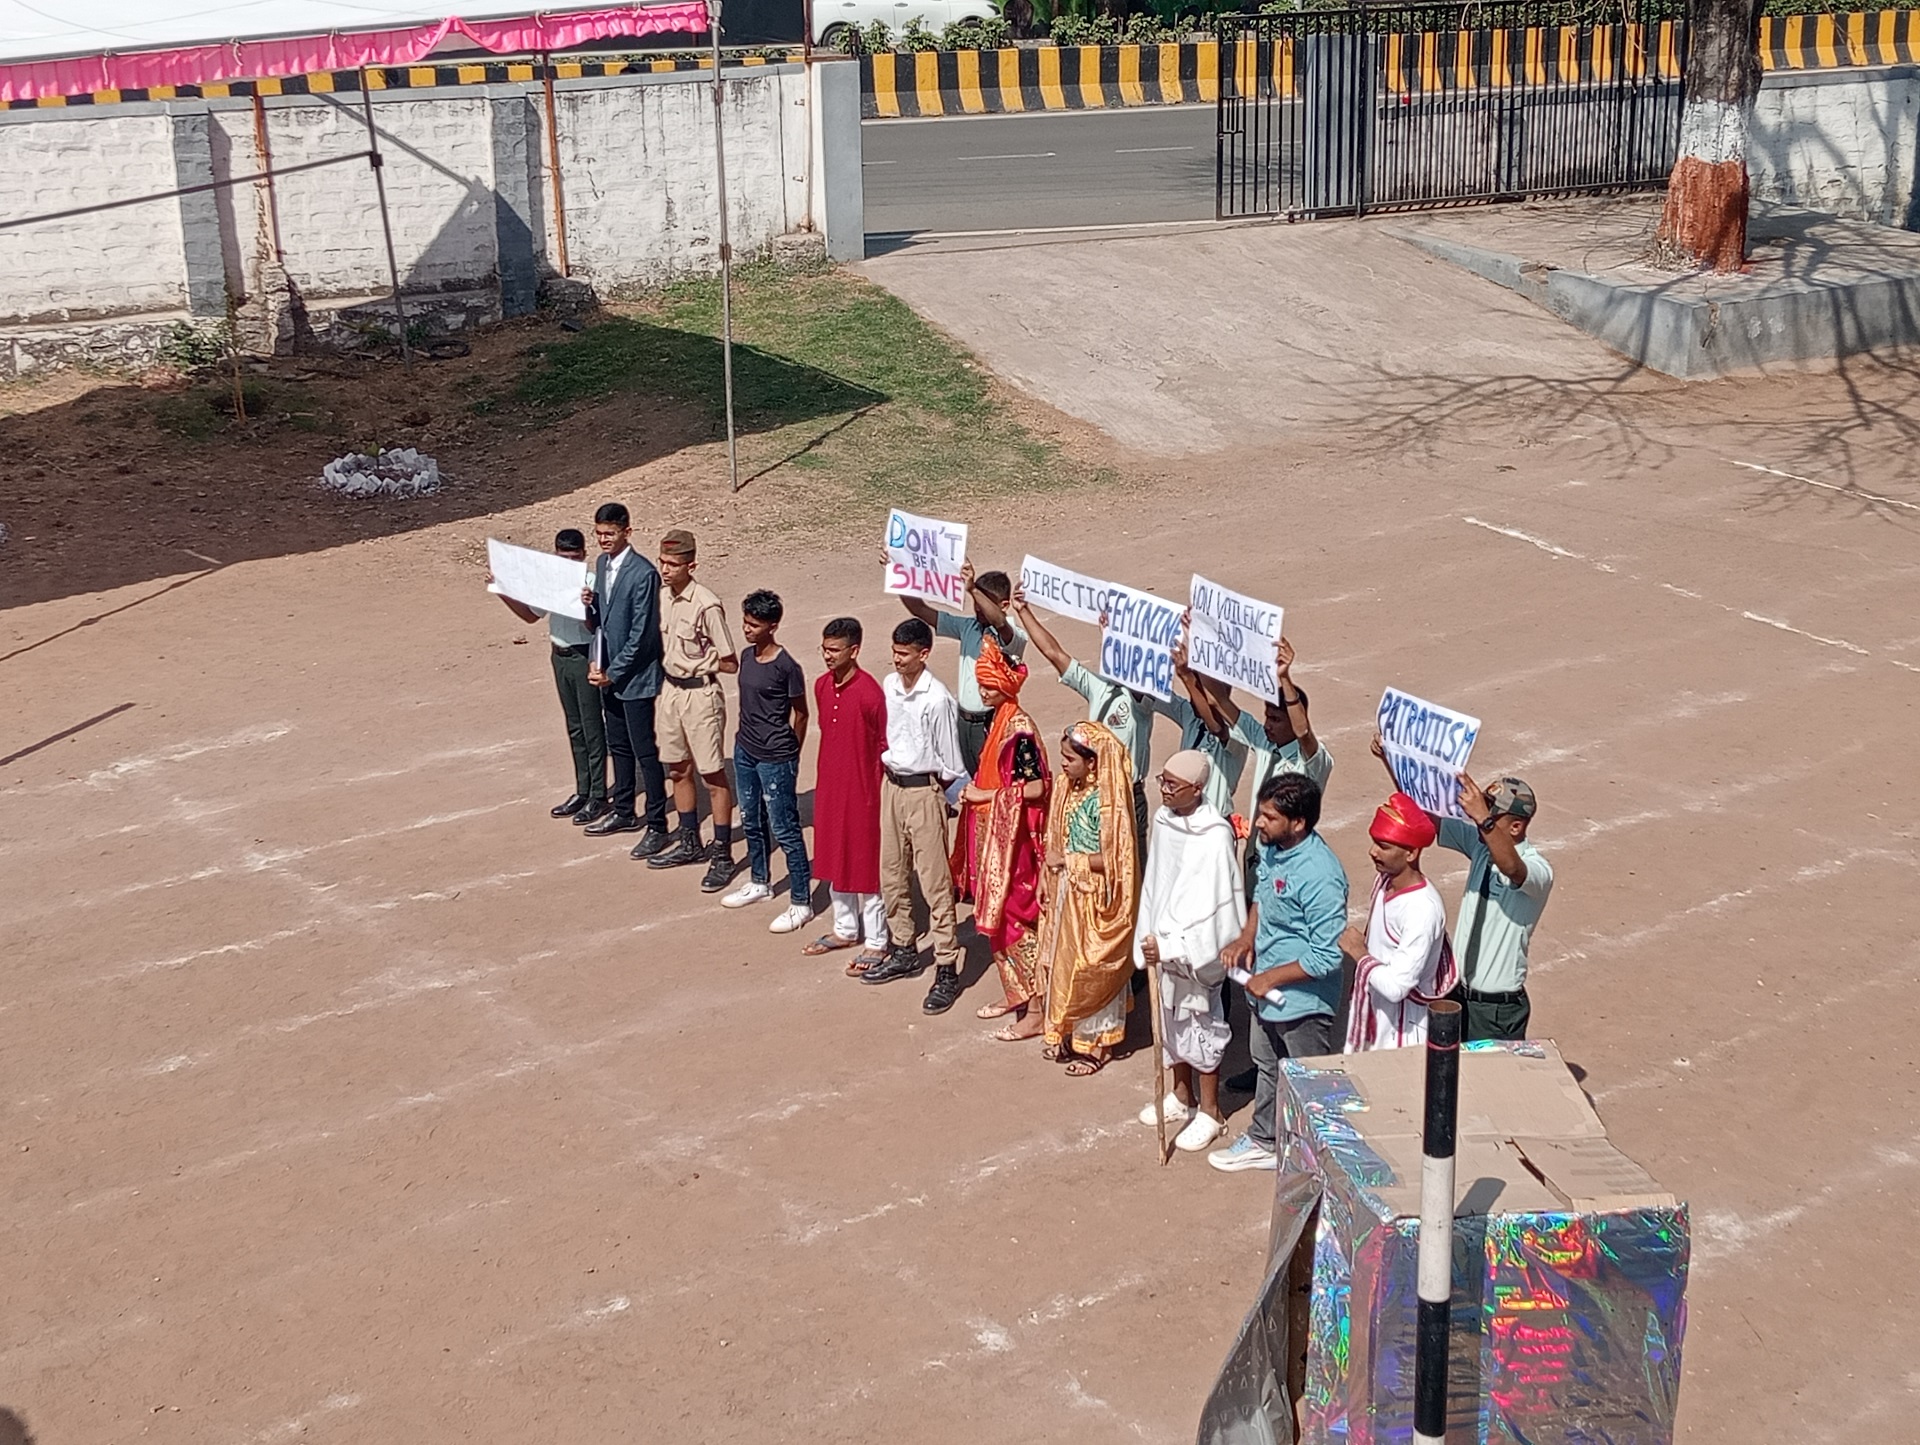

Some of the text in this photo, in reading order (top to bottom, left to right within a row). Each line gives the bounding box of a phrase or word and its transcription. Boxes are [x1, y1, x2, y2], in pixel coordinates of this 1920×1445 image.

[889, 514, 963, 561] DON'T
[889, 563, 962, 604] SLAVE
[912, 553, 940, 572] BE A
[1107, 588, 1181, 648] FEMININE
[1216, 591, 1278, 639] VOILENCE
[1217, 621, 1244, 653] AND
[1102, 636, 1173, 696] COURAGE
[1191, 636, 1276, 695] SATYAGRAHAS
